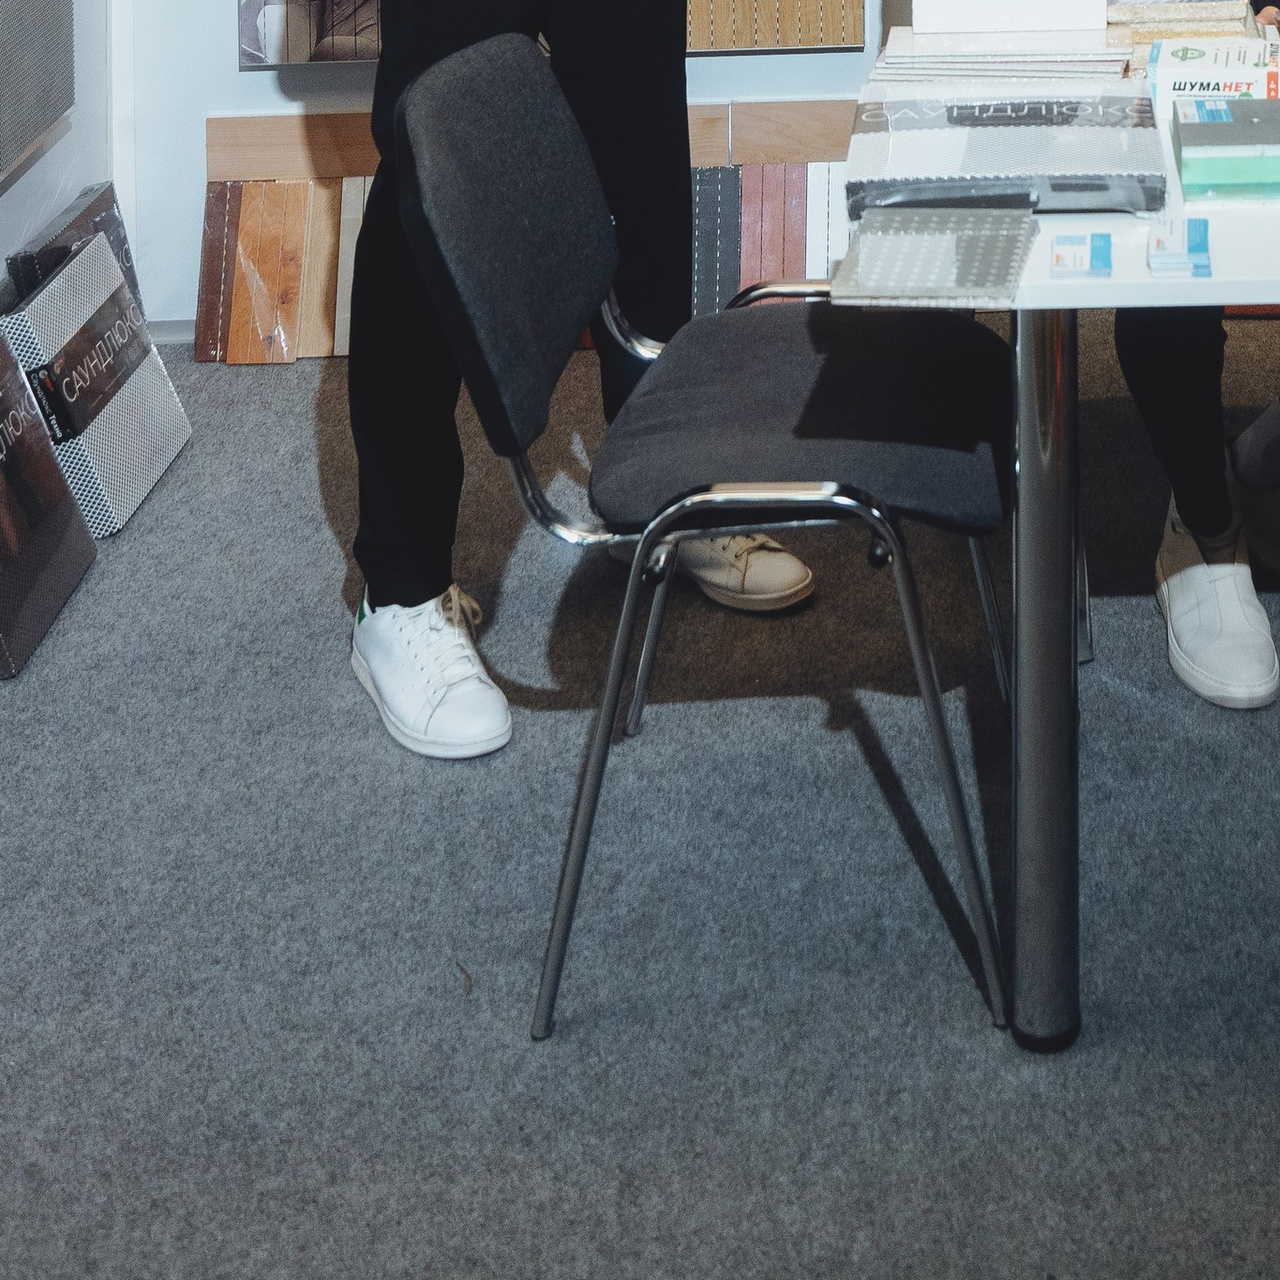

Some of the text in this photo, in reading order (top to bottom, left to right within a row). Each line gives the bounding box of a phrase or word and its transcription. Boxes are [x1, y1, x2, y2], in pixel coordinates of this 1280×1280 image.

[1172, 80, 1255, 93] ШУМАНЕТ
[860, 101, 1154, 123] САУНДЛЮКС
[62, 303, 142, 402] САУНДЛЮКС
[30, 373, 63, 439] Саундлюкс Техно
